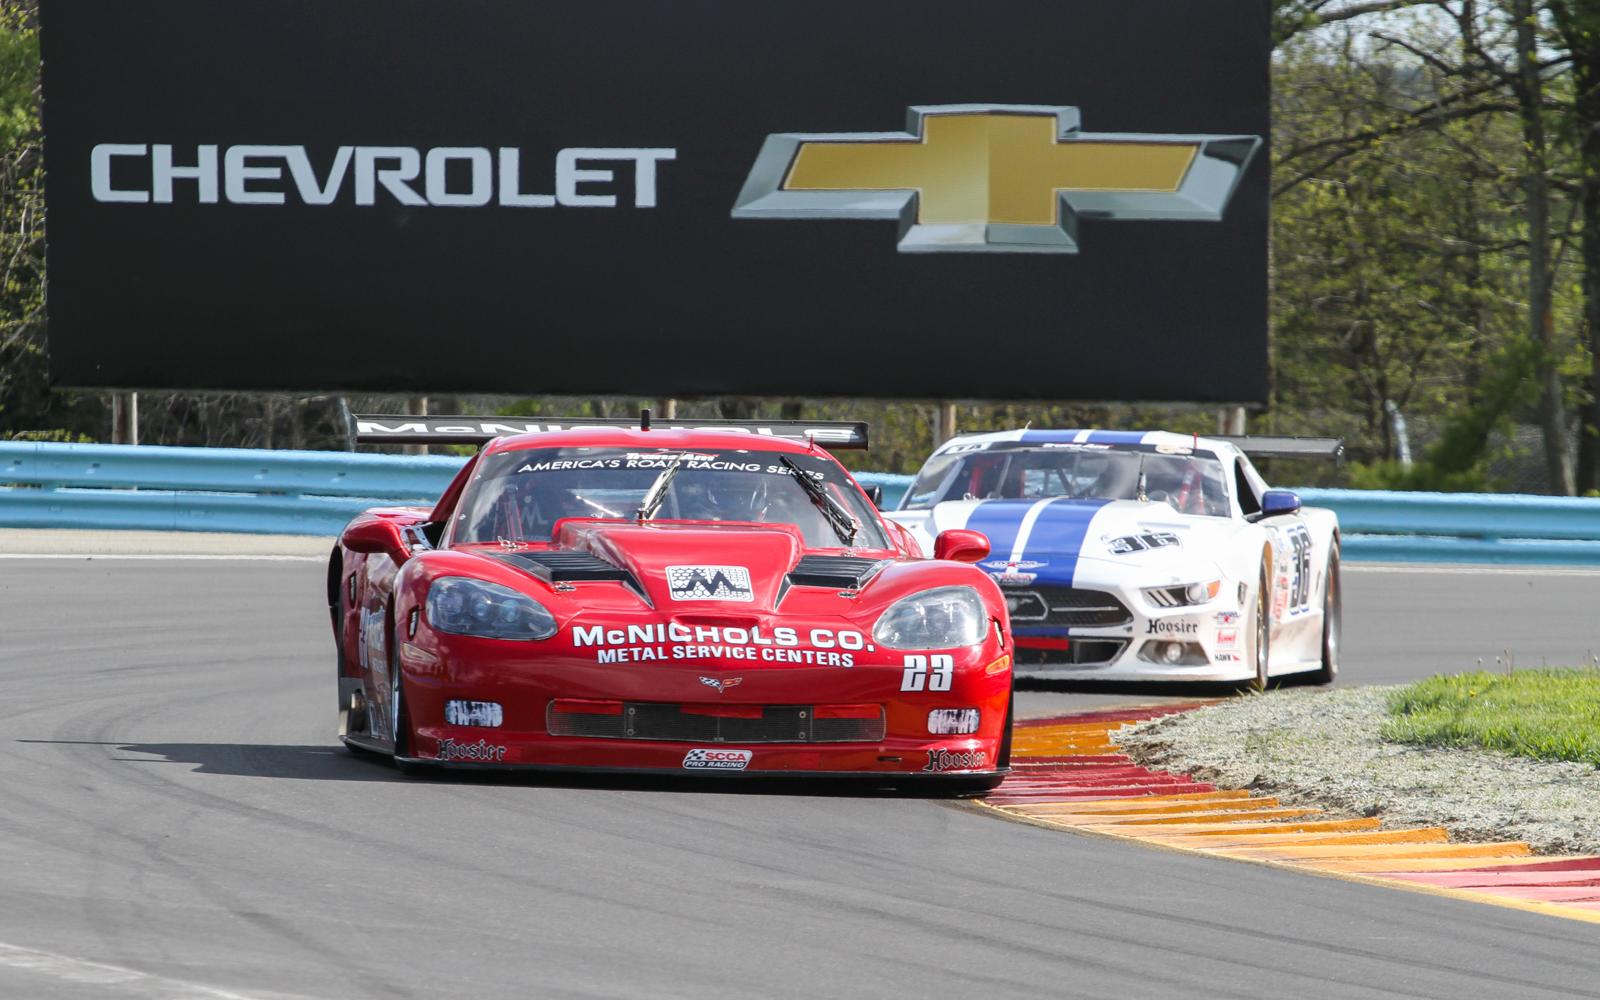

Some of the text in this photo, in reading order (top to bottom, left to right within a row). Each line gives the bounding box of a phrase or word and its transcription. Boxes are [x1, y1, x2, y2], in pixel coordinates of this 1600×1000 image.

[91, 143, 676, 208] CHEVROLET
[518, 460, 620, 474] AMERICA'S
[688, 460, 761, 472] RACING
[572, 623, 875, 652] McNICHOLS CO.
[1145, 618, 1198, 634] Hoosier
[597, 645, 854, 667] METAL SERVICE CENTERS
[900, 654, 954, 691] 23
[436, 738, 507, 761] Hoosier
[705, 752, 747, 761] SCCA
[922, 748, 986, 771] Hoosier
